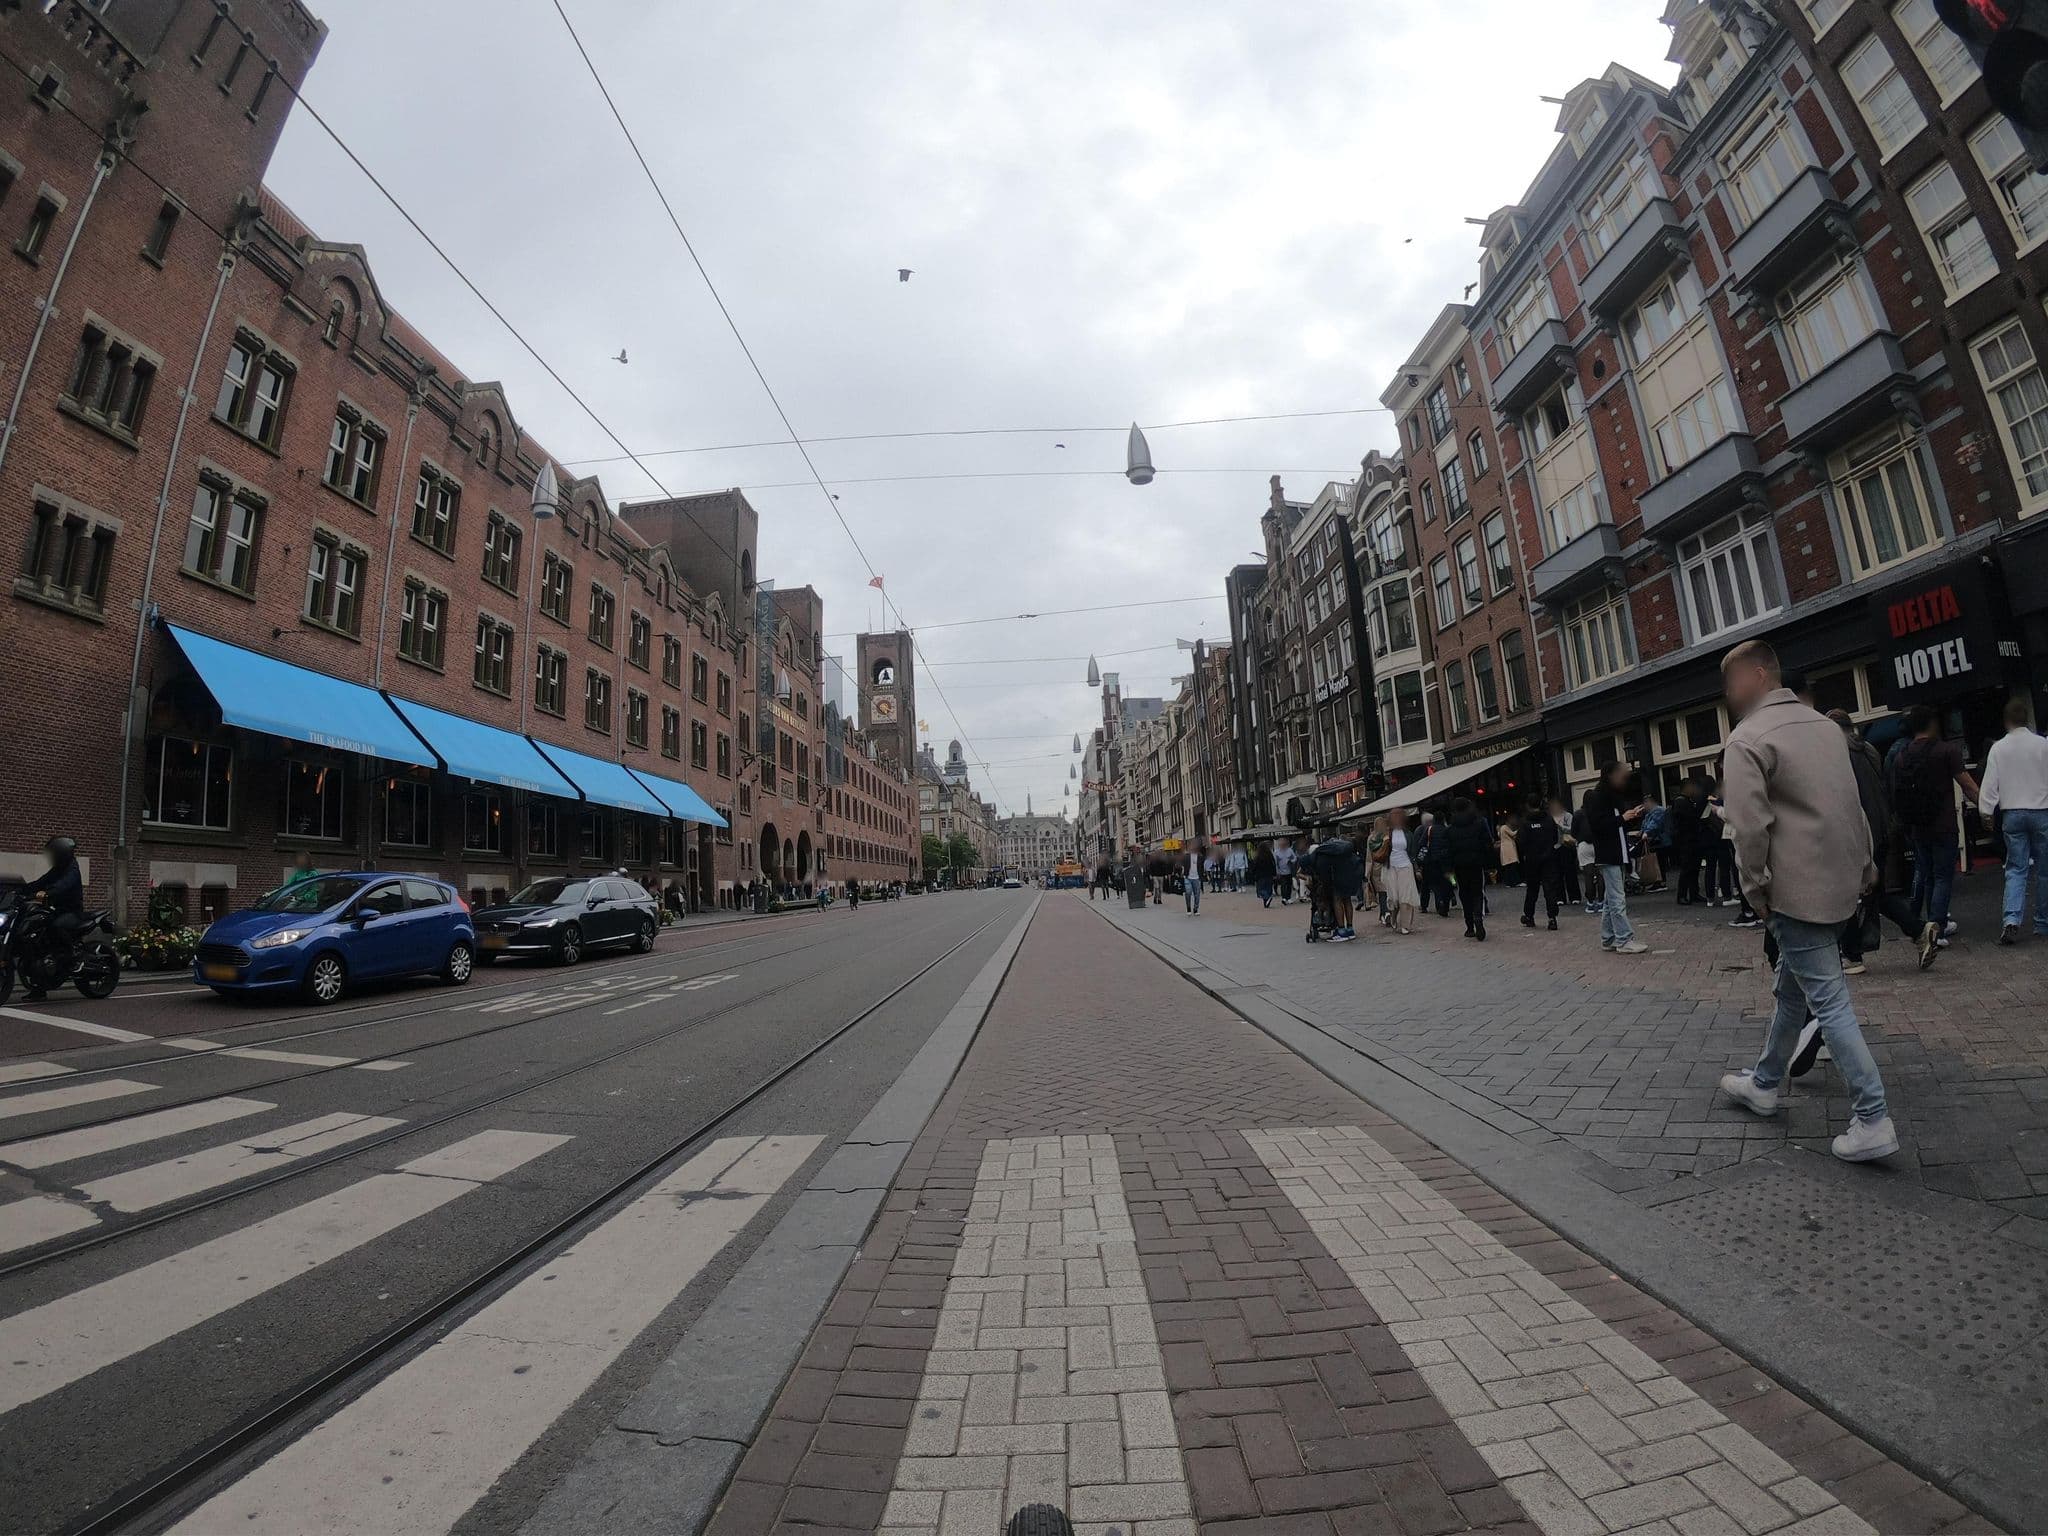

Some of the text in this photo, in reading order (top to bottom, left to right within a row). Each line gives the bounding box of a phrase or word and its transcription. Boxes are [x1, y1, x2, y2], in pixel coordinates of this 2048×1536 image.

[1888, 585, 1961, 638] DELTA
[1997, 641, 2022, 657] HOTEL
[1894, 637, 1972, 689] HOTEL
[1315, 684, 1329, 704] Hotel
[309, 731, 376, 755] THE SEAFOOD BAR
[1087, 782, 1114, 790] CASINO
